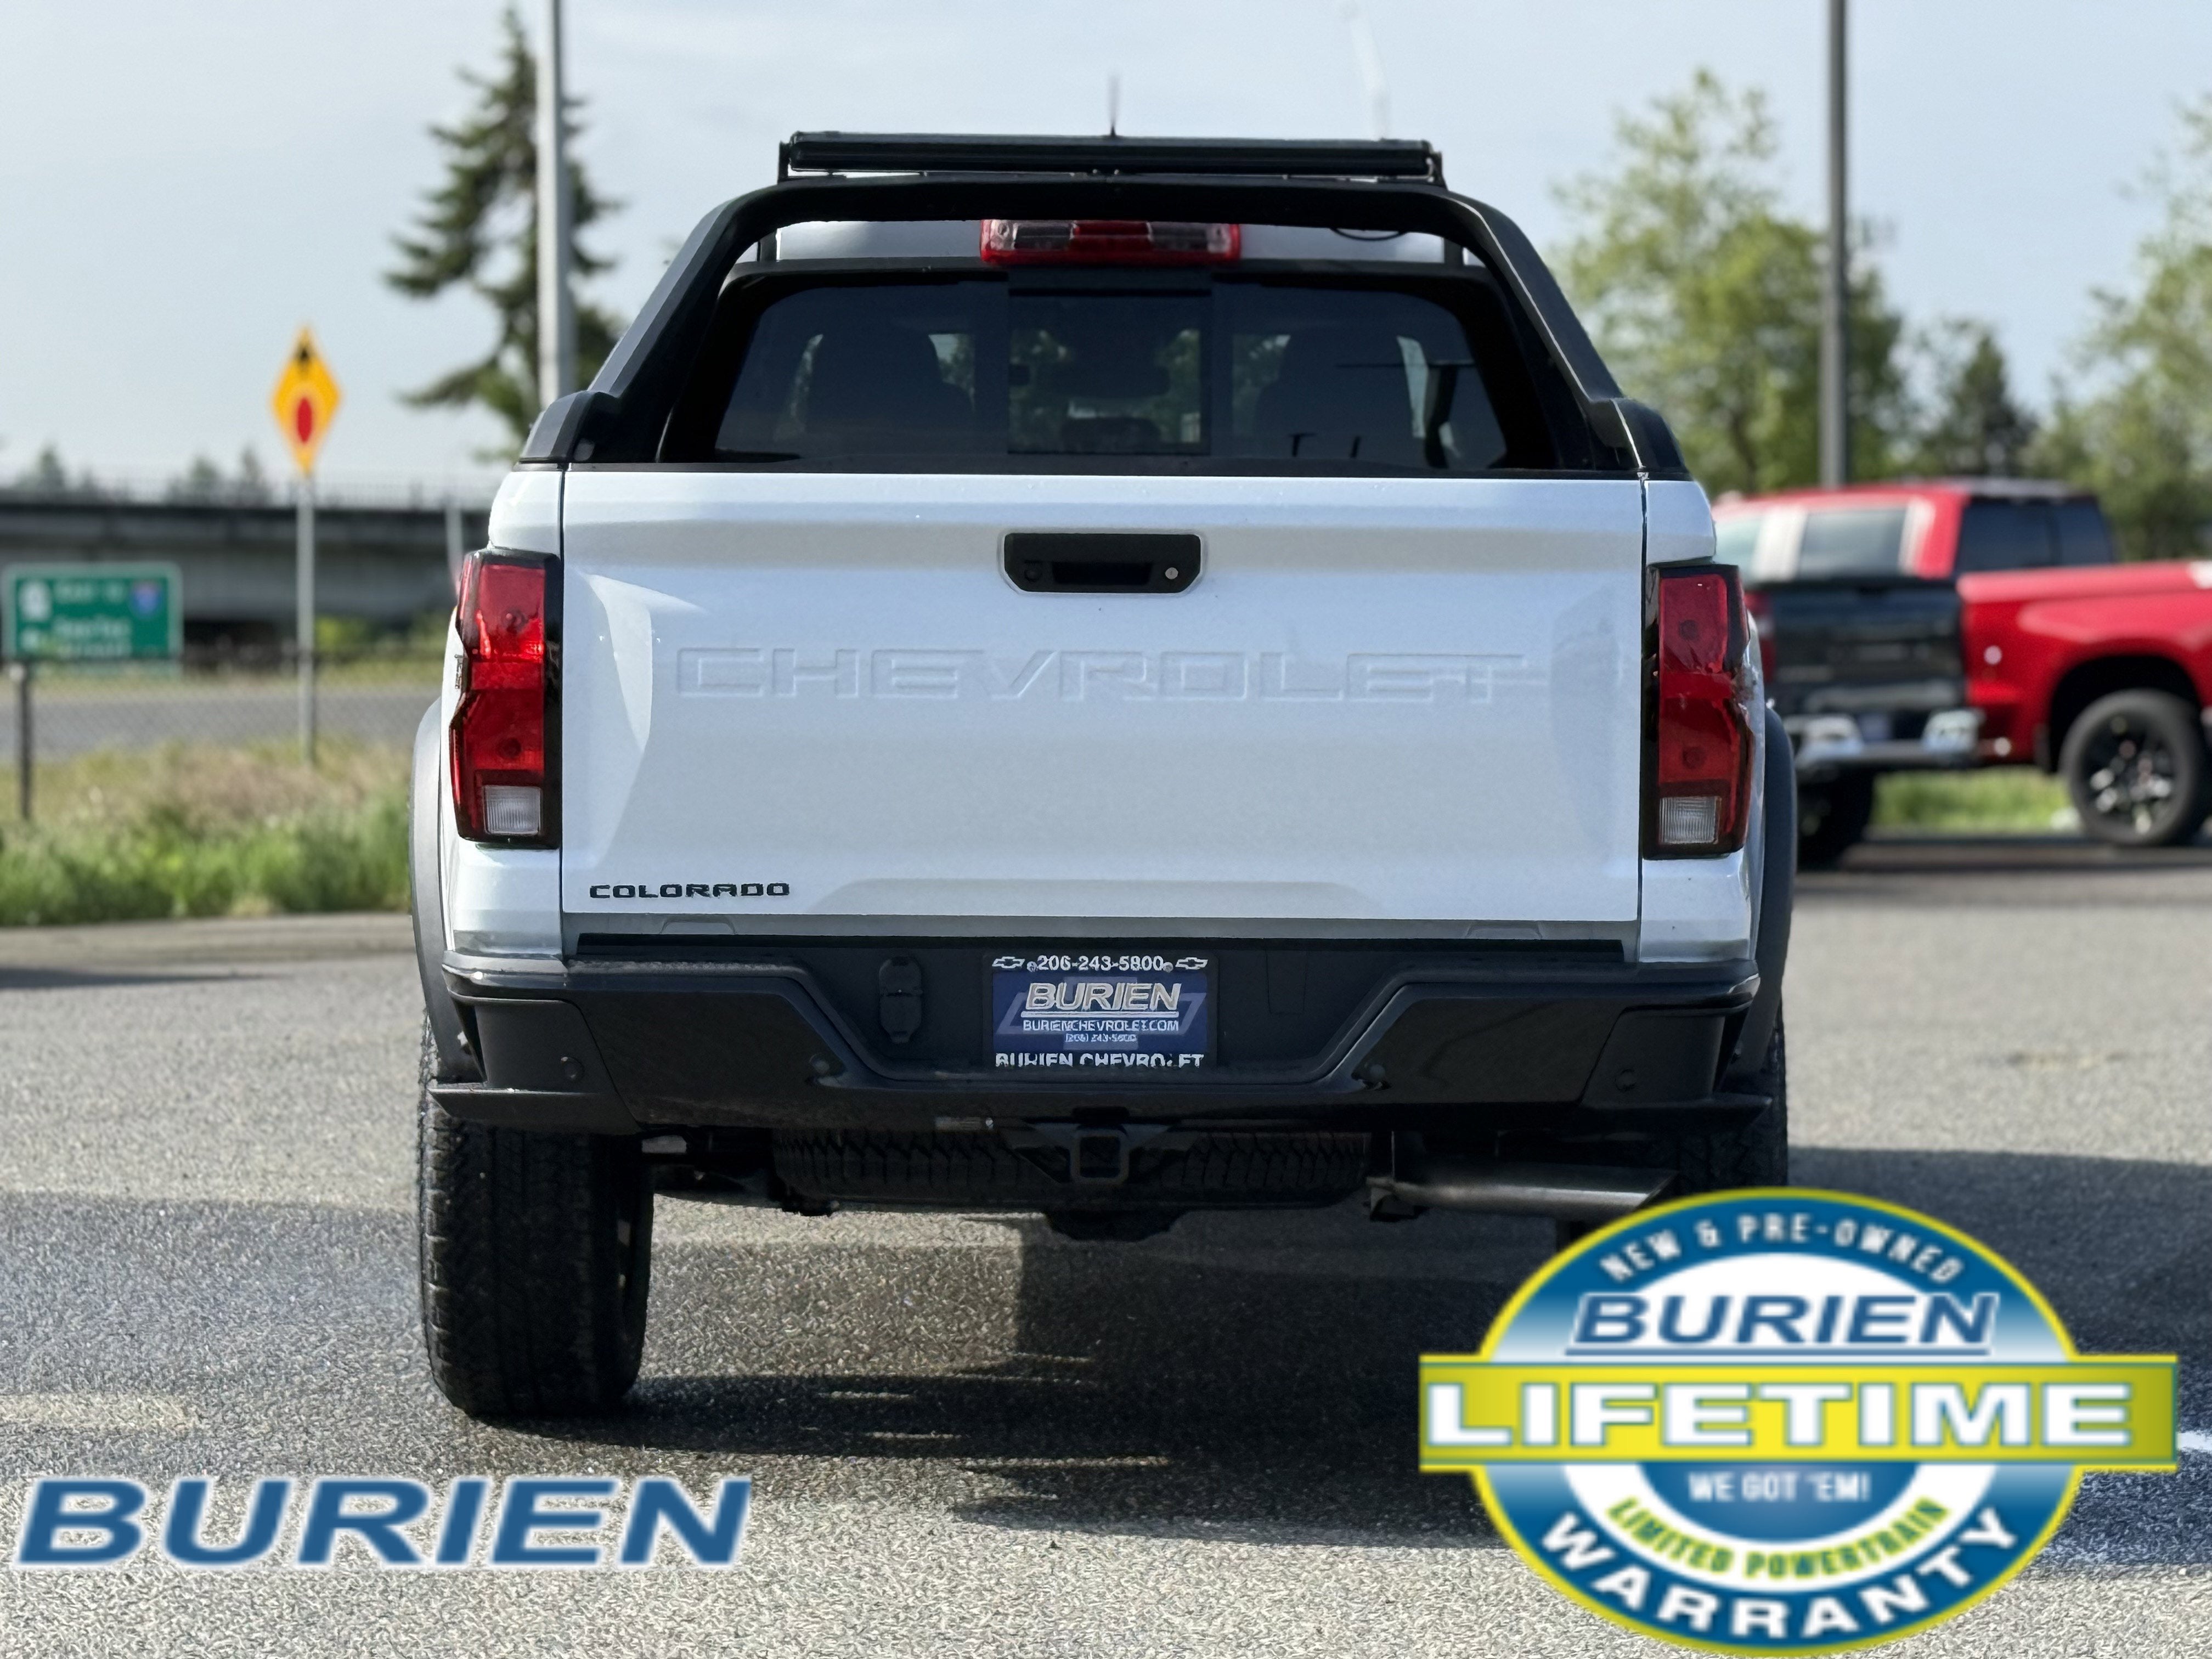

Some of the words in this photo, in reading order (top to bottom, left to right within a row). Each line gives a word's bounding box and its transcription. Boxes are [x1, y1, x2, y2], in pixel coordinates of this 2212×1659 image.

[678, 647, 1548, 706] CHEVROLET
[589, 883, 790, 899] COLORADO
[1036, 955, 1163, 971] 206-243-5800
[1025, 983, 1182, 1011] BURIEN
[1079, 1053, 1204, 1067] CHEVROET
